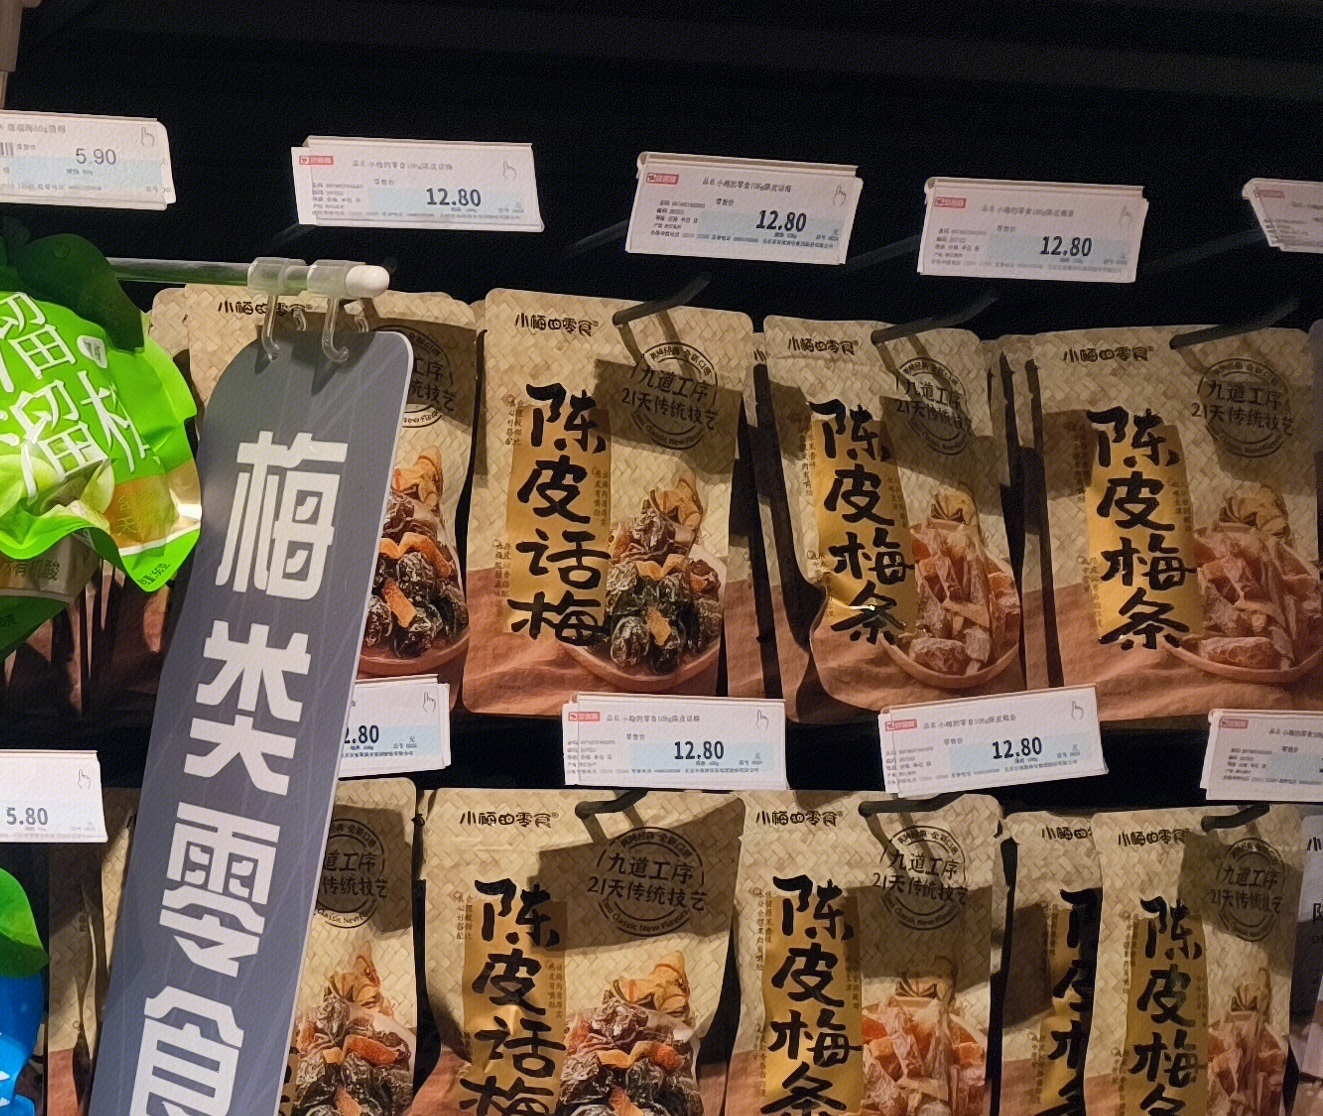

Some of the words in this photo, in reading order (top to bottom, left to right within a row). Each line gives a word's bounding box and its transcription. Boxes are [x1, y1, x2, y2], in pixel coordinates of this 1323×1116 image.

[75, 147, 118, 167] 5.90
[426, 187, 482, 209] 12.80
[755, 208, 808, 234] 12.80
[1040, 234, 1093, 259] 12.80
[636, 364, 715, 400] 九道工序
[1206, 378, 1284, 410] 九道工序
[620, 386, 720, 432] 21天传统技艺
[506, 382, 611, 648] 陈皮话梅
[807, 398, 913, 648] 陈皮梅条
[1087, 406, 1197, 651] 陈皮梅条
[673, 740, 725, 761] 12.80
[992, 736, 1043, 761] 12.80
[6, 806, 49, 828] 5.80
[606, 851, 696, 886] 九道工序
[886, 848, 960, 879] 九道工序
[586, 874, 709, 912] 21天传统技艺
[871, 870, 971, 907] 21天传统技艺
